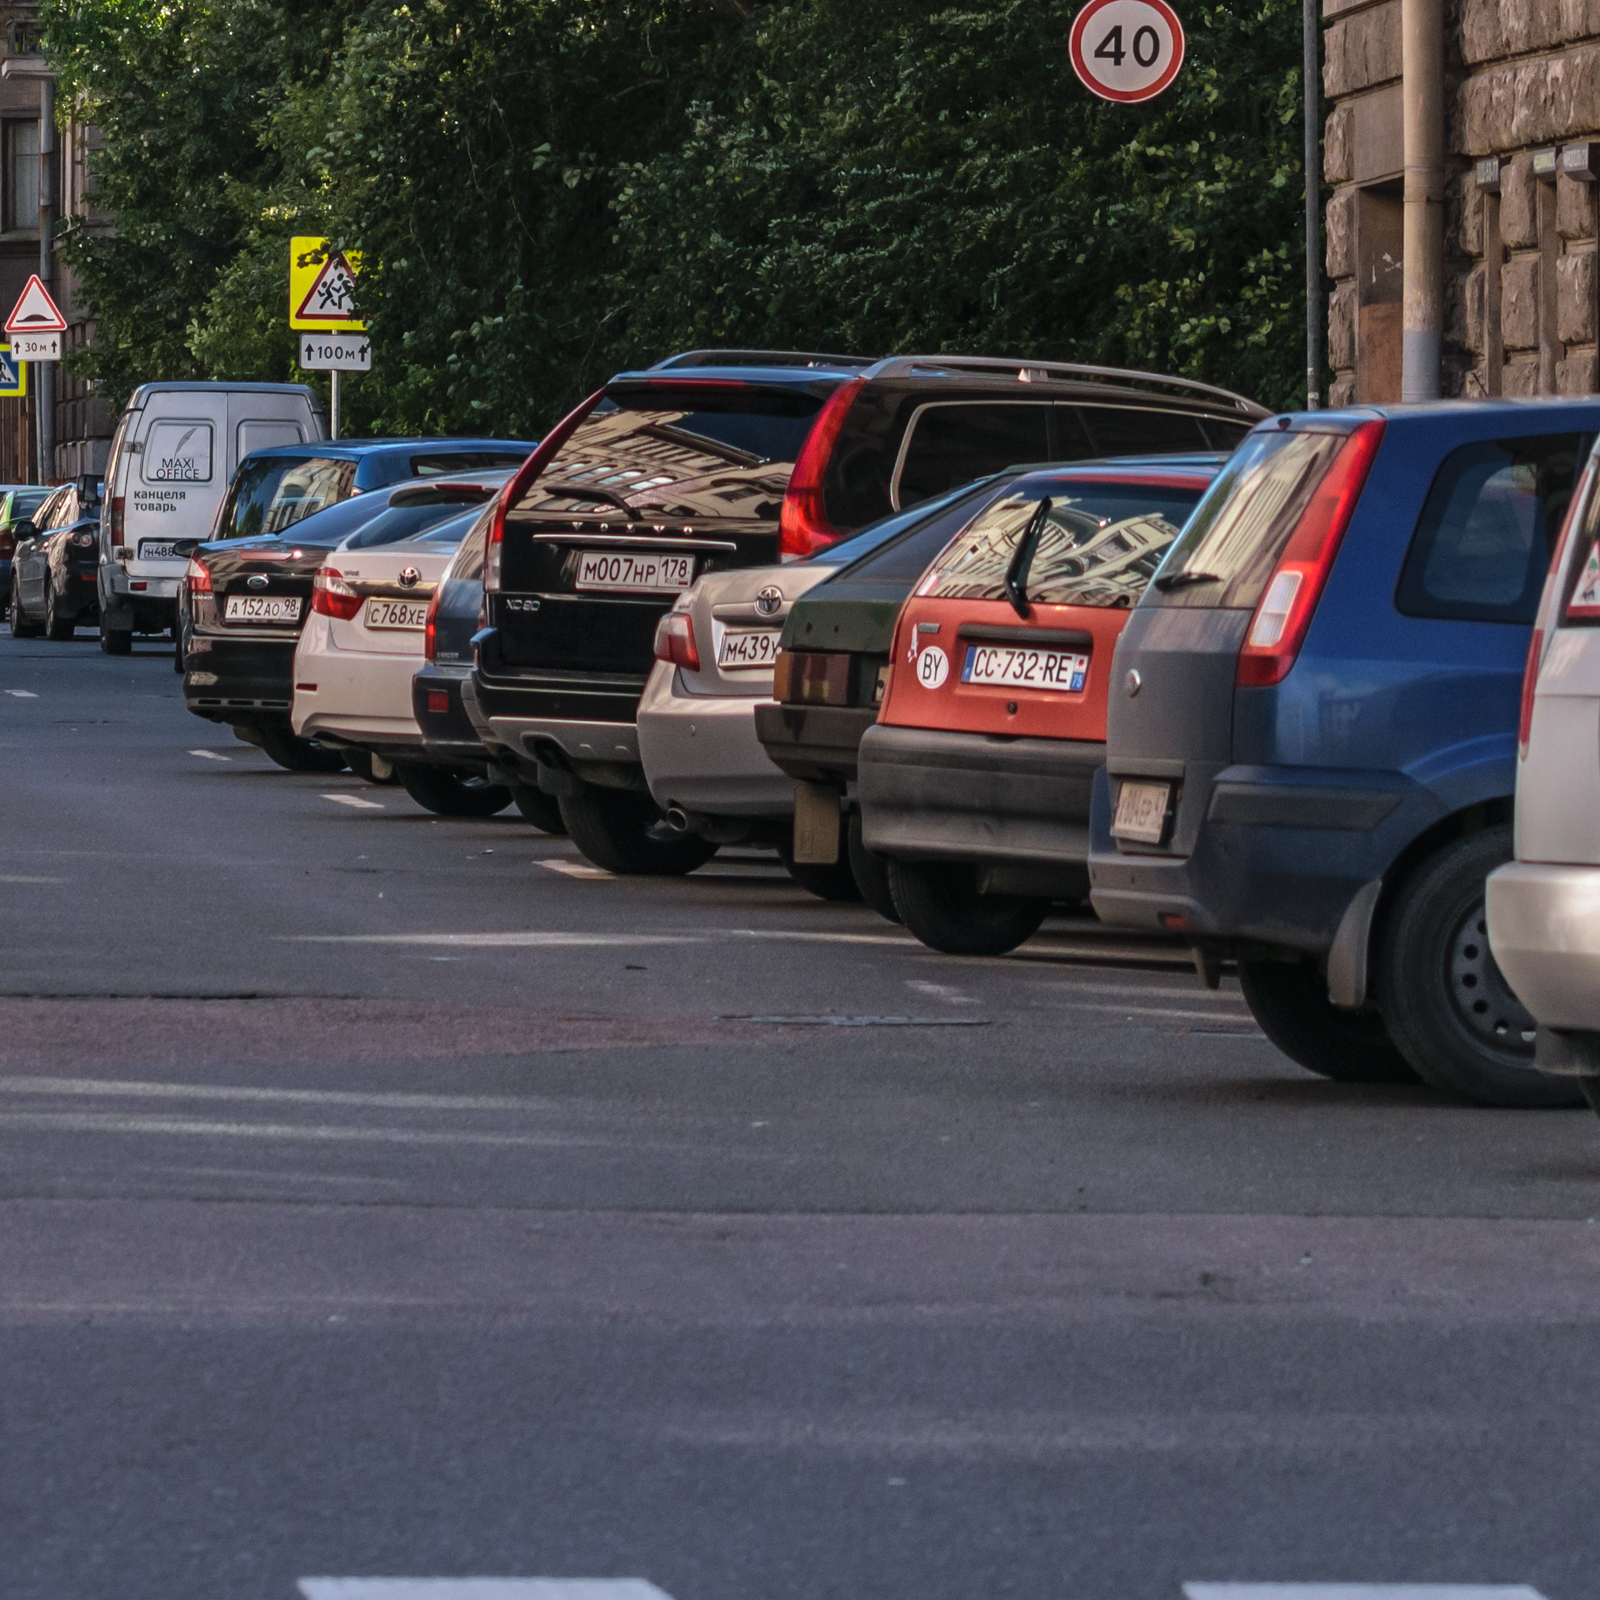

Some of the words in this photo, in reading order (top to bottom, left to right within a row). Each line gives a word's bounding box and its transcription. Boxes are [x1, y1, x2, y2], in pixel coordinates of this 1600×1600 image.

[1094, 25, 1160, 68] 40
[25, 342, 38, 353] 30
[161, 458, 195, 469] MAXI
[156, 468, 200, 480] OFFICE
[133, 491, 186, 501] канцеля
[133, 502, 177, 513] товарь
[661, 558, 688, 578] 178
[283, 598, 297, 613] 98
[922, 652, 942, 682] BY
[974, 648, 1073, 684] CC-732-RE
[1071, 673, 1083, 688] 75
